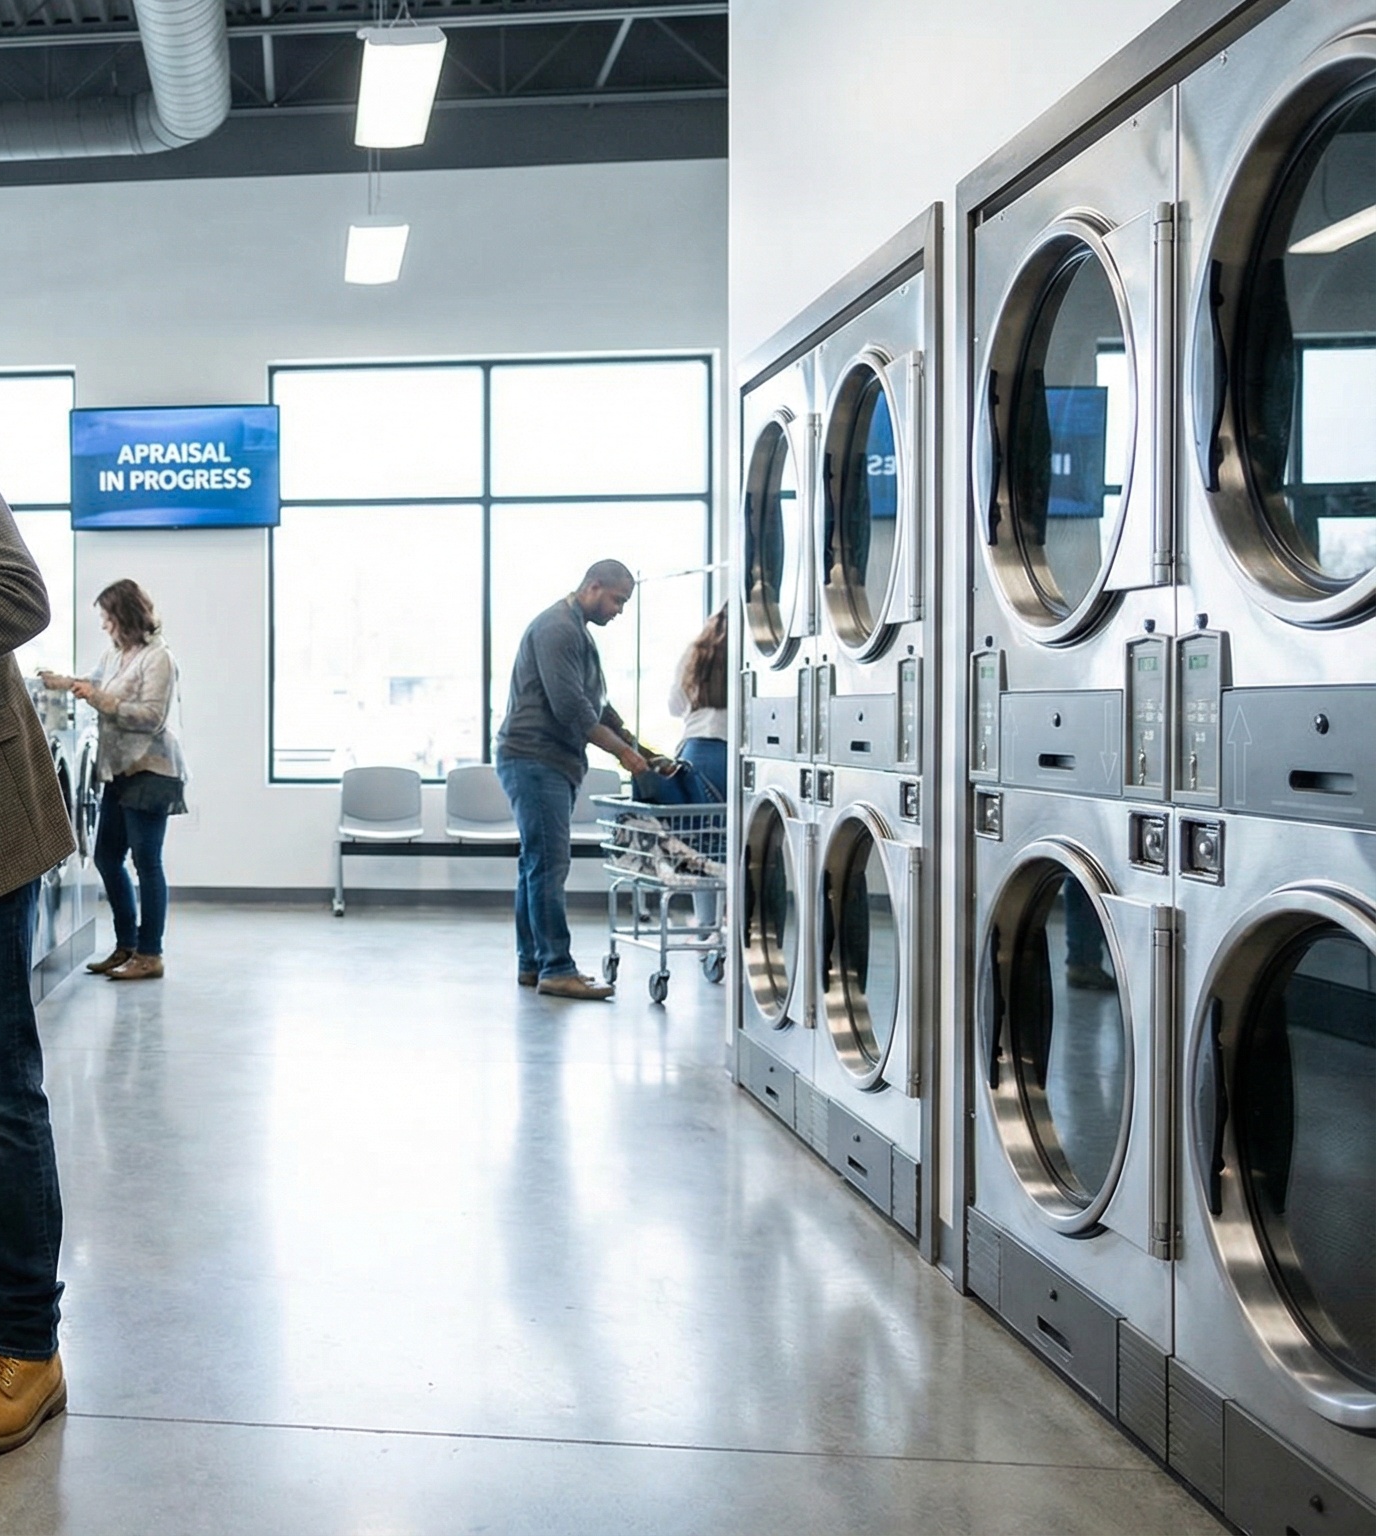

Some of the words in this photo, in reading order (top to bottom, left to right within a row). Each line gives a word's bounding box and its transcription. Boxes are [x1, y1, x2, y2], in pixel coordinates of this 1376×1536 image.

[117, 442, 231, 464] APRAISAL
[99, 470, 124, 492] IN
[129, 467, 252, 491] PROGRESS
